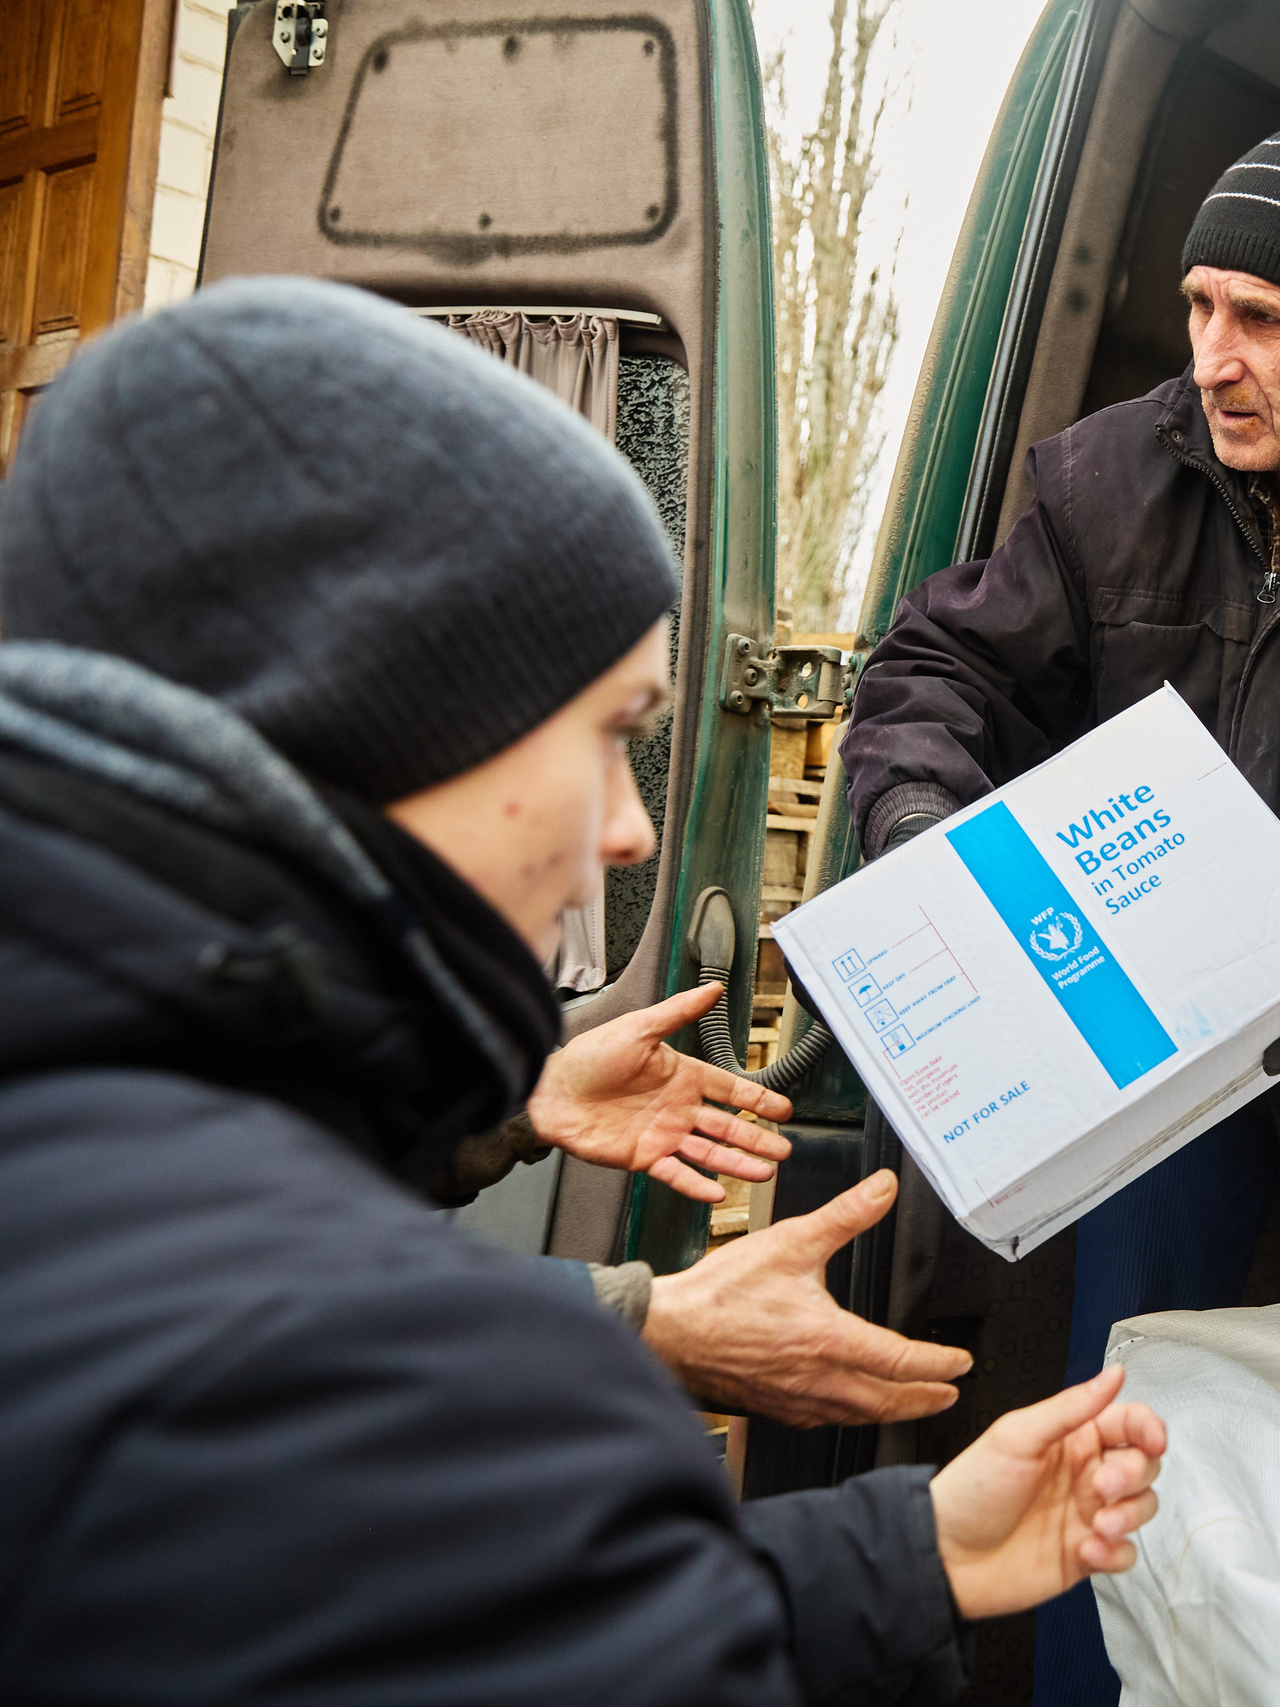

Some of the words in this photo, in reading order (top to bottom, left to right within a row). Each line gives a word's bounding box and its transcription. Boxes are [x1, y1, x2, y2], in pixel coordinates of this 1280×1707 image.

[1055, 785, 1155, 849] White
[1074, 809, 1172, 876] Beans
[1091, 879, 1114, 896] in
[1111, 832, 1186, 881] Tomato
[1105, 874, 1162, 915] Sauce
[1030, 906, 1055, 926] WFP
[882, 979, 895, 991] KEEP
[895, 972, 906, 983] DRY
[1051, 959, 1079, 981] World
[1077, 945, 1100, 964] Food
[1057, 955, 1106, 990] Programme
[898, 1004, 912, 1016] KEEP
[911, 994, 928, 1007] AWAY
[927, 983, 945, 996] FROM
[943, 975, 957, 986] HEAT
[915, 1021, 943, 1042] MAXIMUM
[942, 1005, 968, 1024] STACKING
[966, 995, 981, 1008] LIMIT
[943, 1119, 971, 1144] NOT
[972, 1101, 1000, 1124] FOR
[999, 1080, 1031, 1106] SALE
